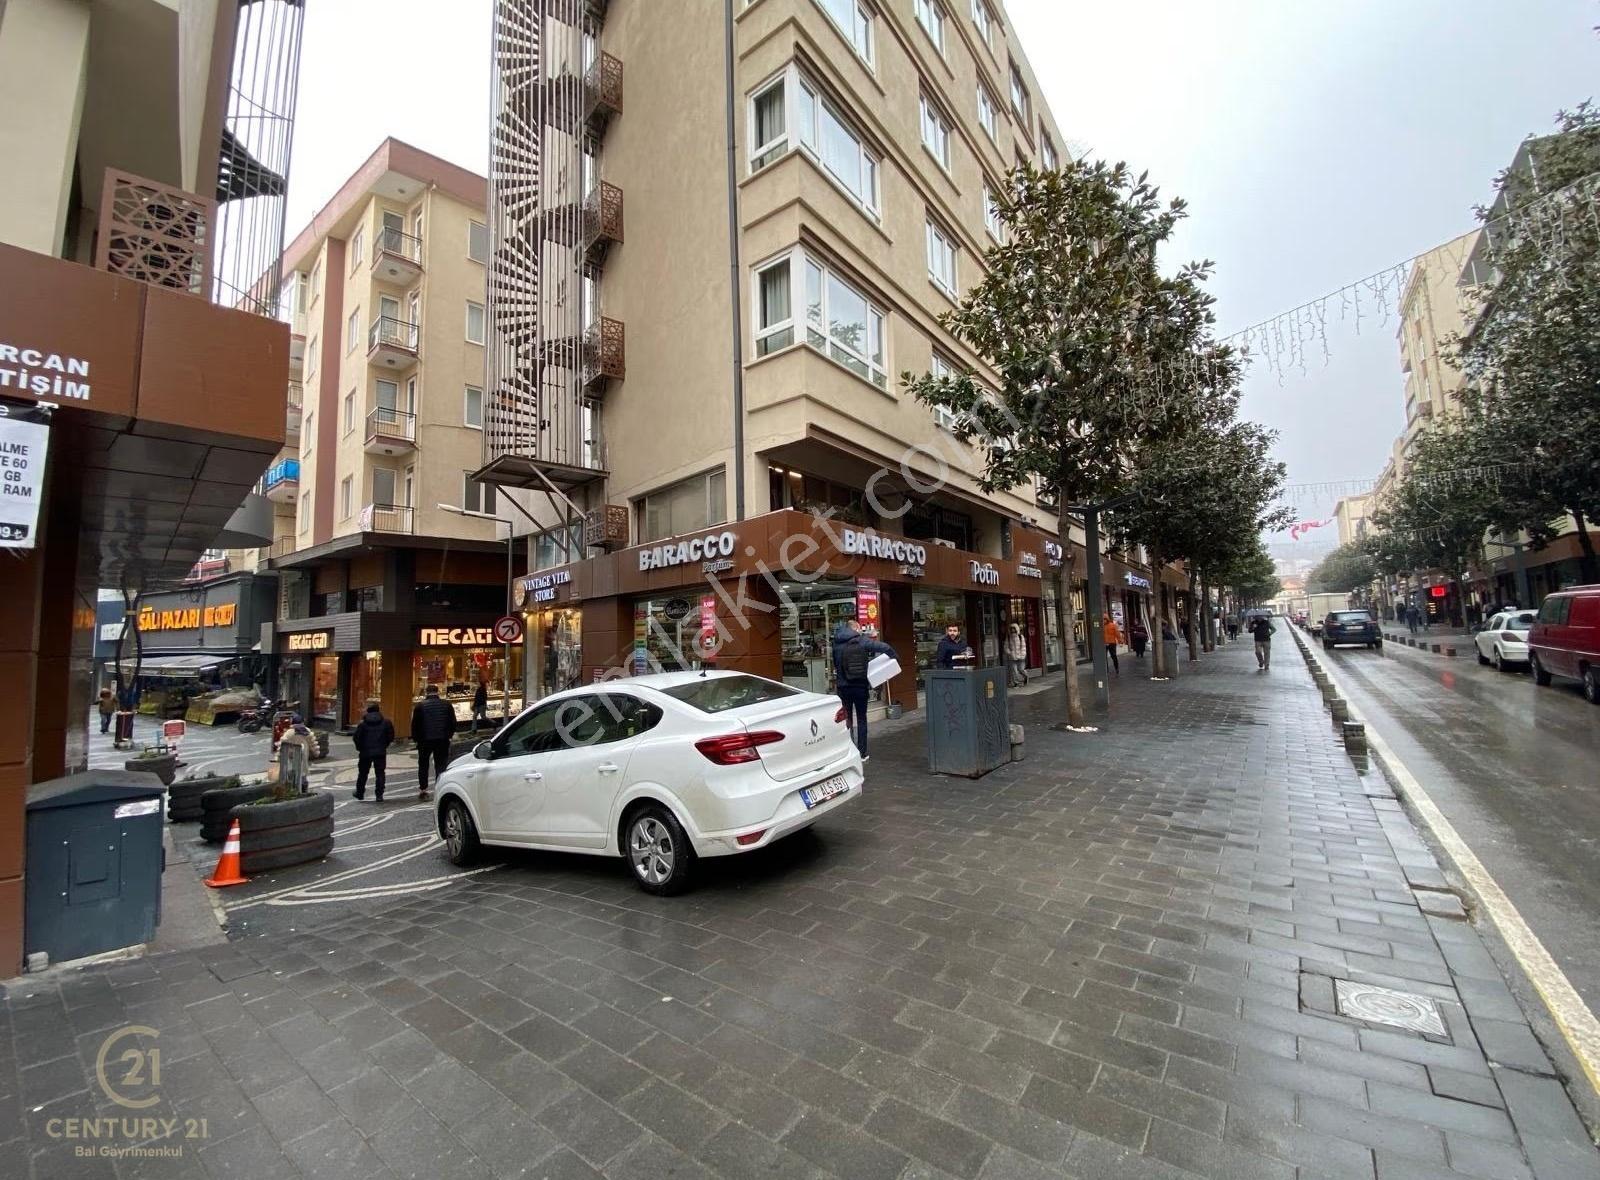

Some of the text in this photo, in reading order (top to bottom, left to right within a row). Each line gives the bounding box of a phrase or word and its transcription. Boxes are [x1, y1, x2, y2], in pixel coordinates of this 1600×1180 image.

[13, 458, 28, 470] 60
[4, 470, 21, 482] GB
[3, 484, 32, 497] RAM
[639, 531, 737, 571] BARACCO
[844, 529, 927, 566] BARACCO
[968, 559, 1000, 587] Potin
[524, 576, 551, 591] VINTAGE
[535, 588, 555, 602] STORE
[820, 781, 834, 797] ALS
